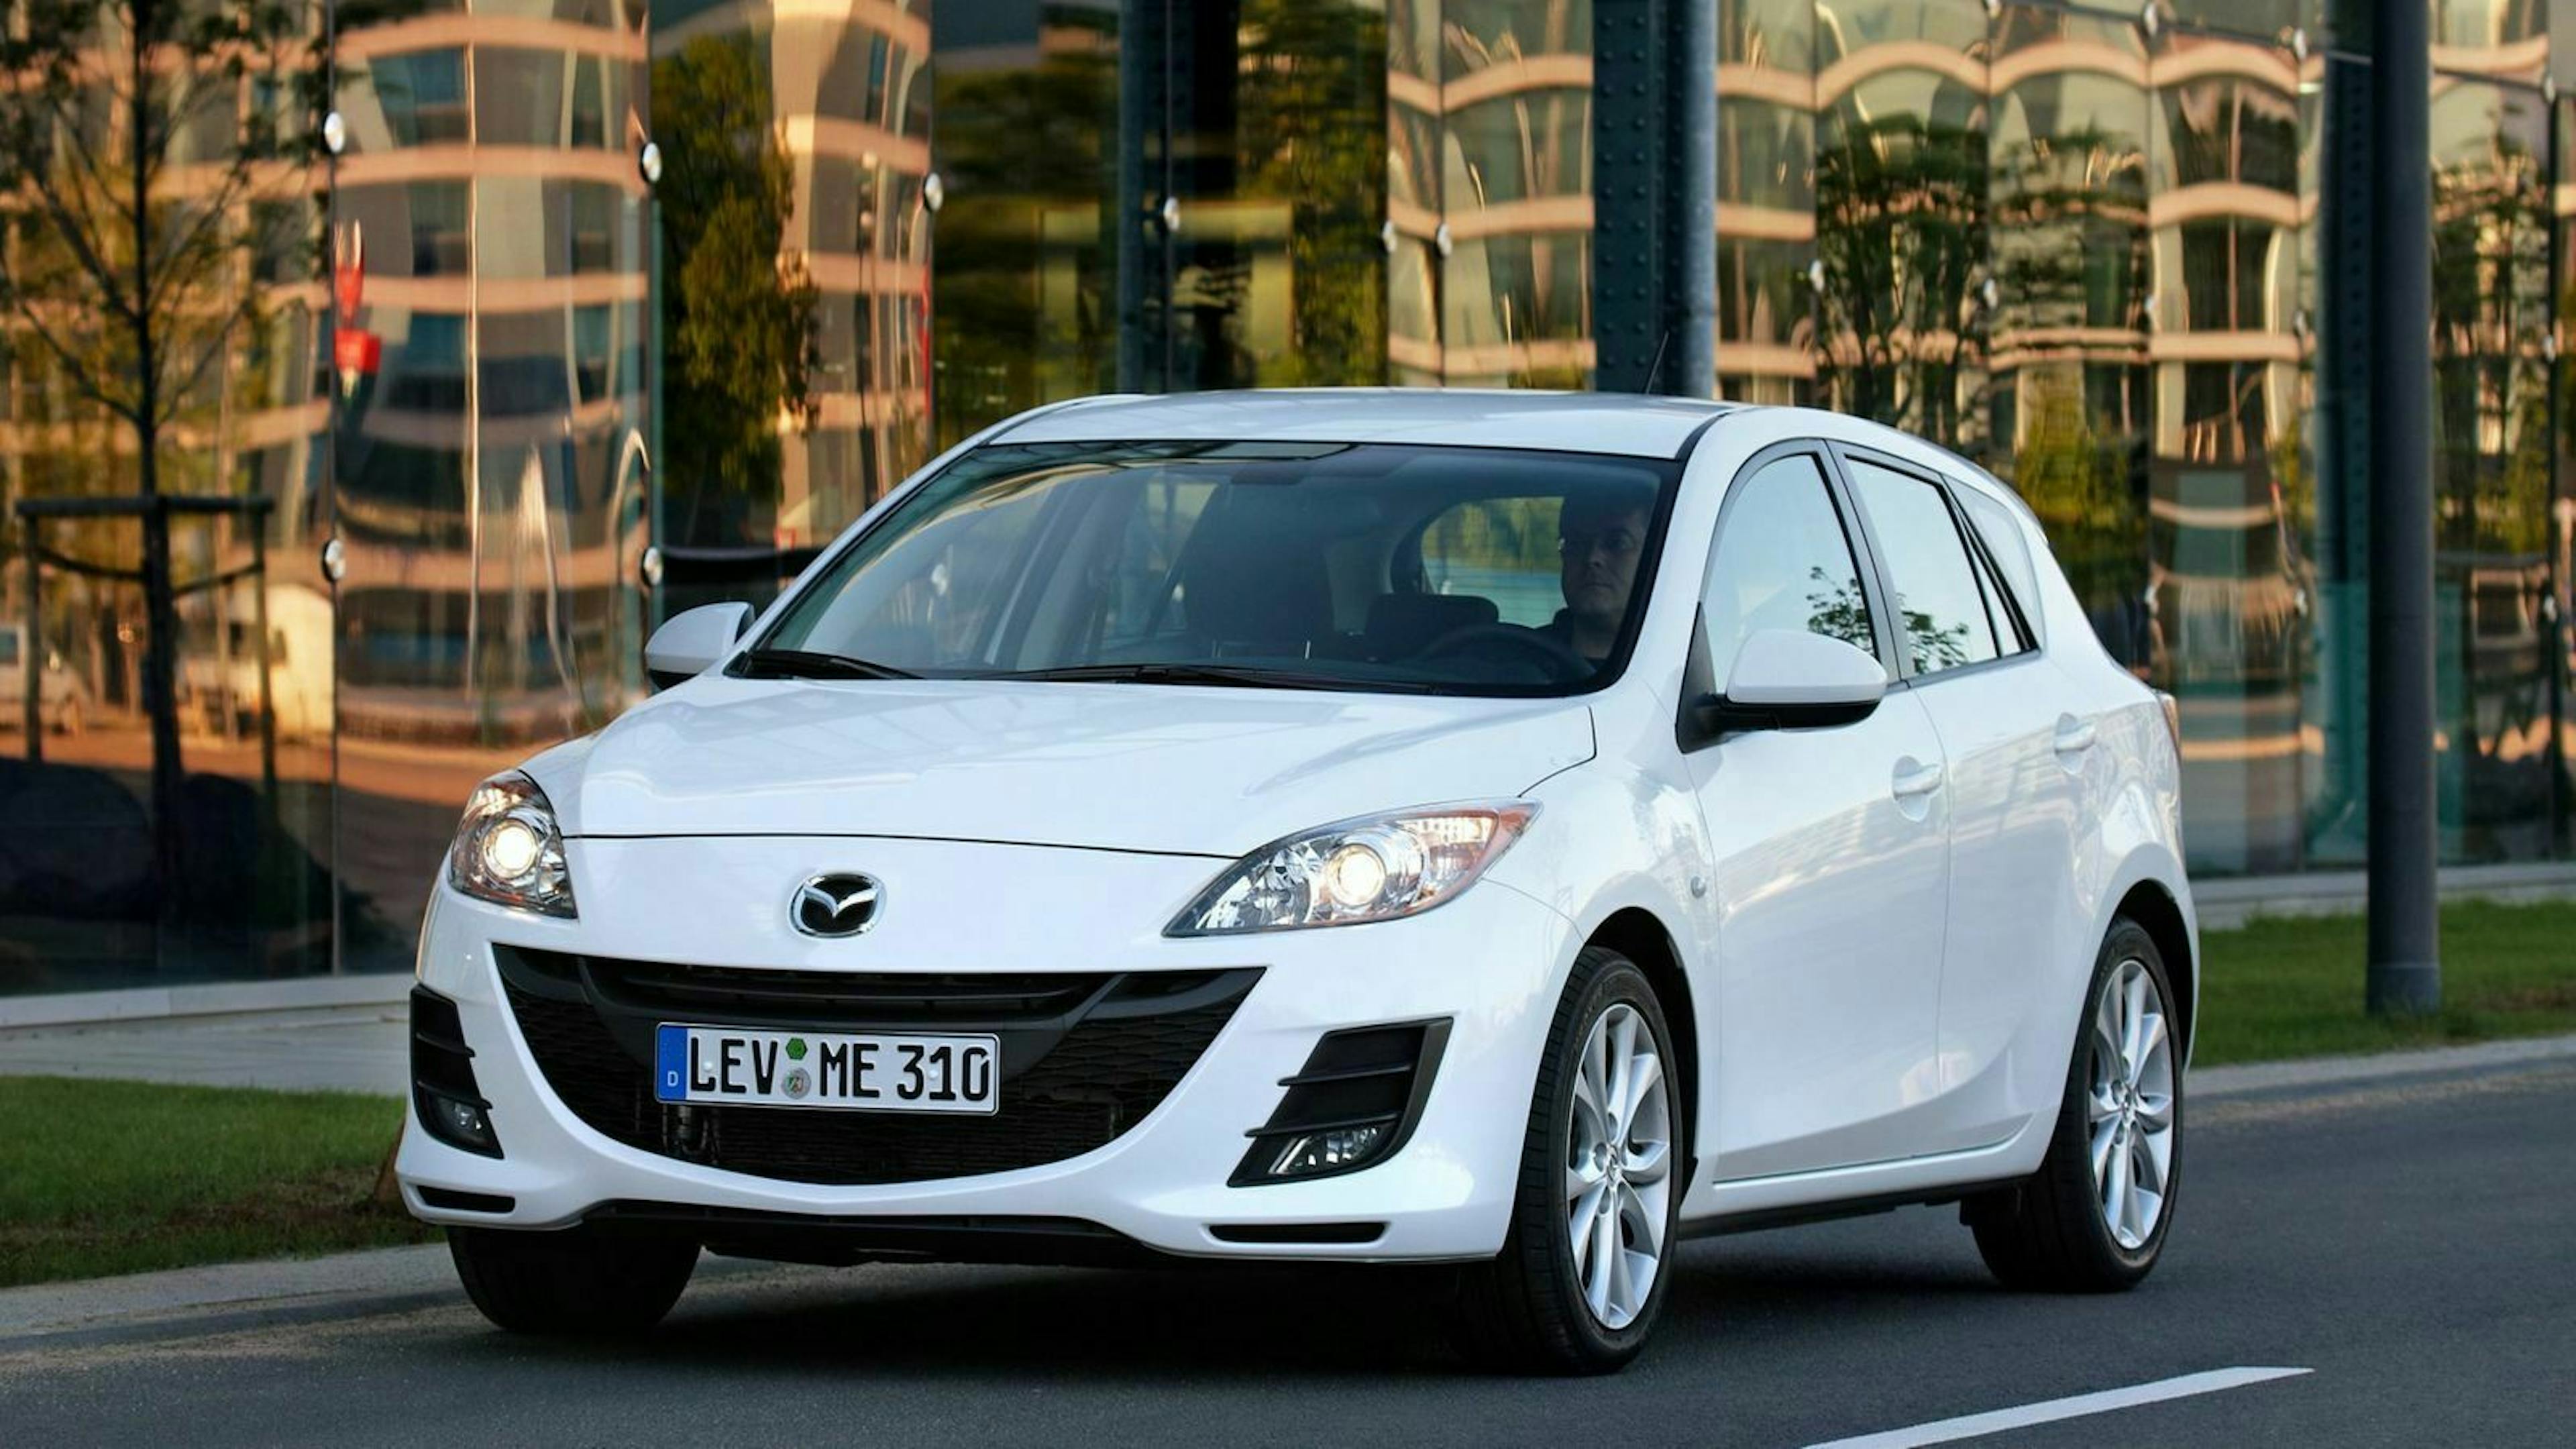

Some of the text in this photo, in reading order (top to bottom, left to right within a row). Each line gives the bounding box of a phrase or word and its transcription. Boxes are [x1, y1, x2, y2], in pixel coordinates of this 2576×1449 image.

[667, 1071, 679, 1087] D
[690, 1036, 989, 1102] LEV ME 310
